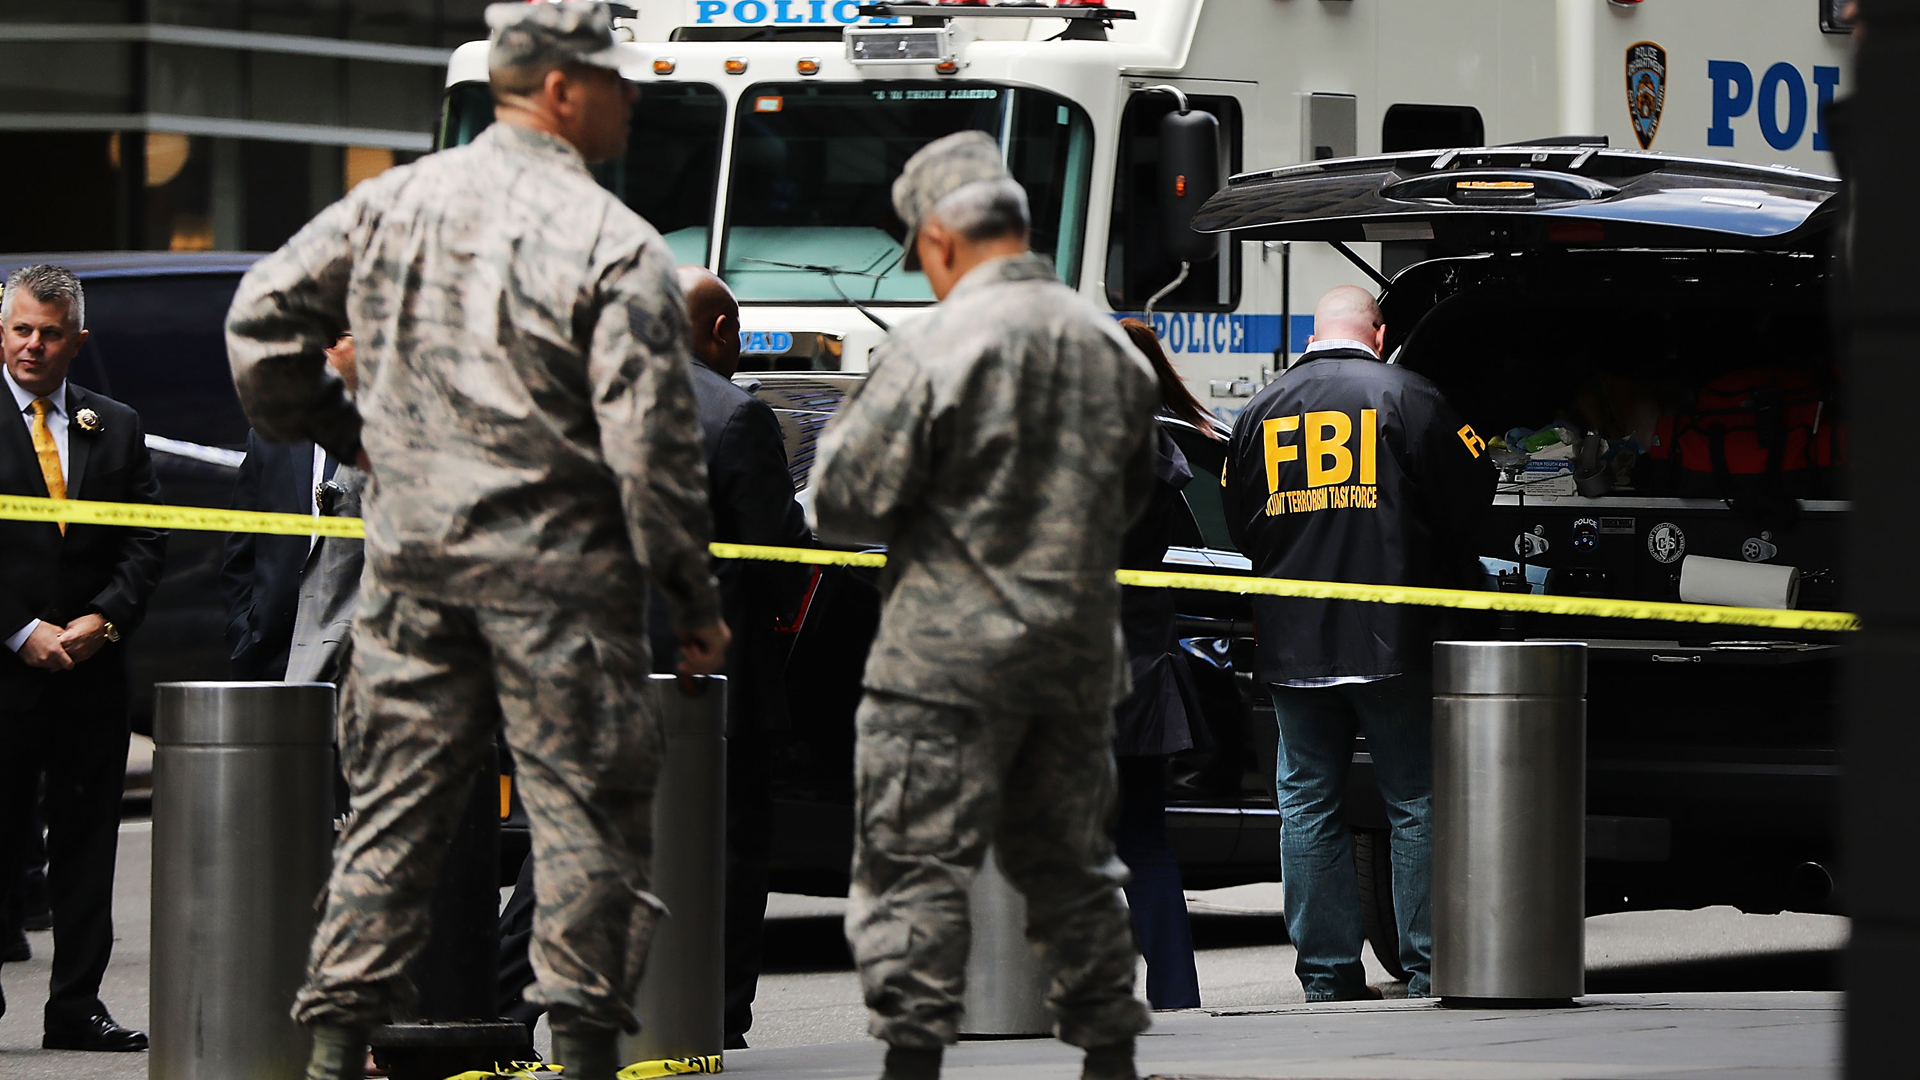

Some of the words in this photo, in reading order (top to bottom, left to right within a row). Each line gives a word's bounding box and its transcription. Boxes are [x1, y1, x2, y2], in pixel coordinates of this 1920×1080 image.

[1152, 313, 1245, 354] POLICE
[1263, 409, 1377, 494] FBI
[1265, 491, 1286, 517] JOINT
[1286, 487, 1328, 514] TERRORISM
[1329, 486, 1349, 509] TASK
[1350, 485, 1378, 509] FORCE
[1573, 517, 1599, 530] POLICE
